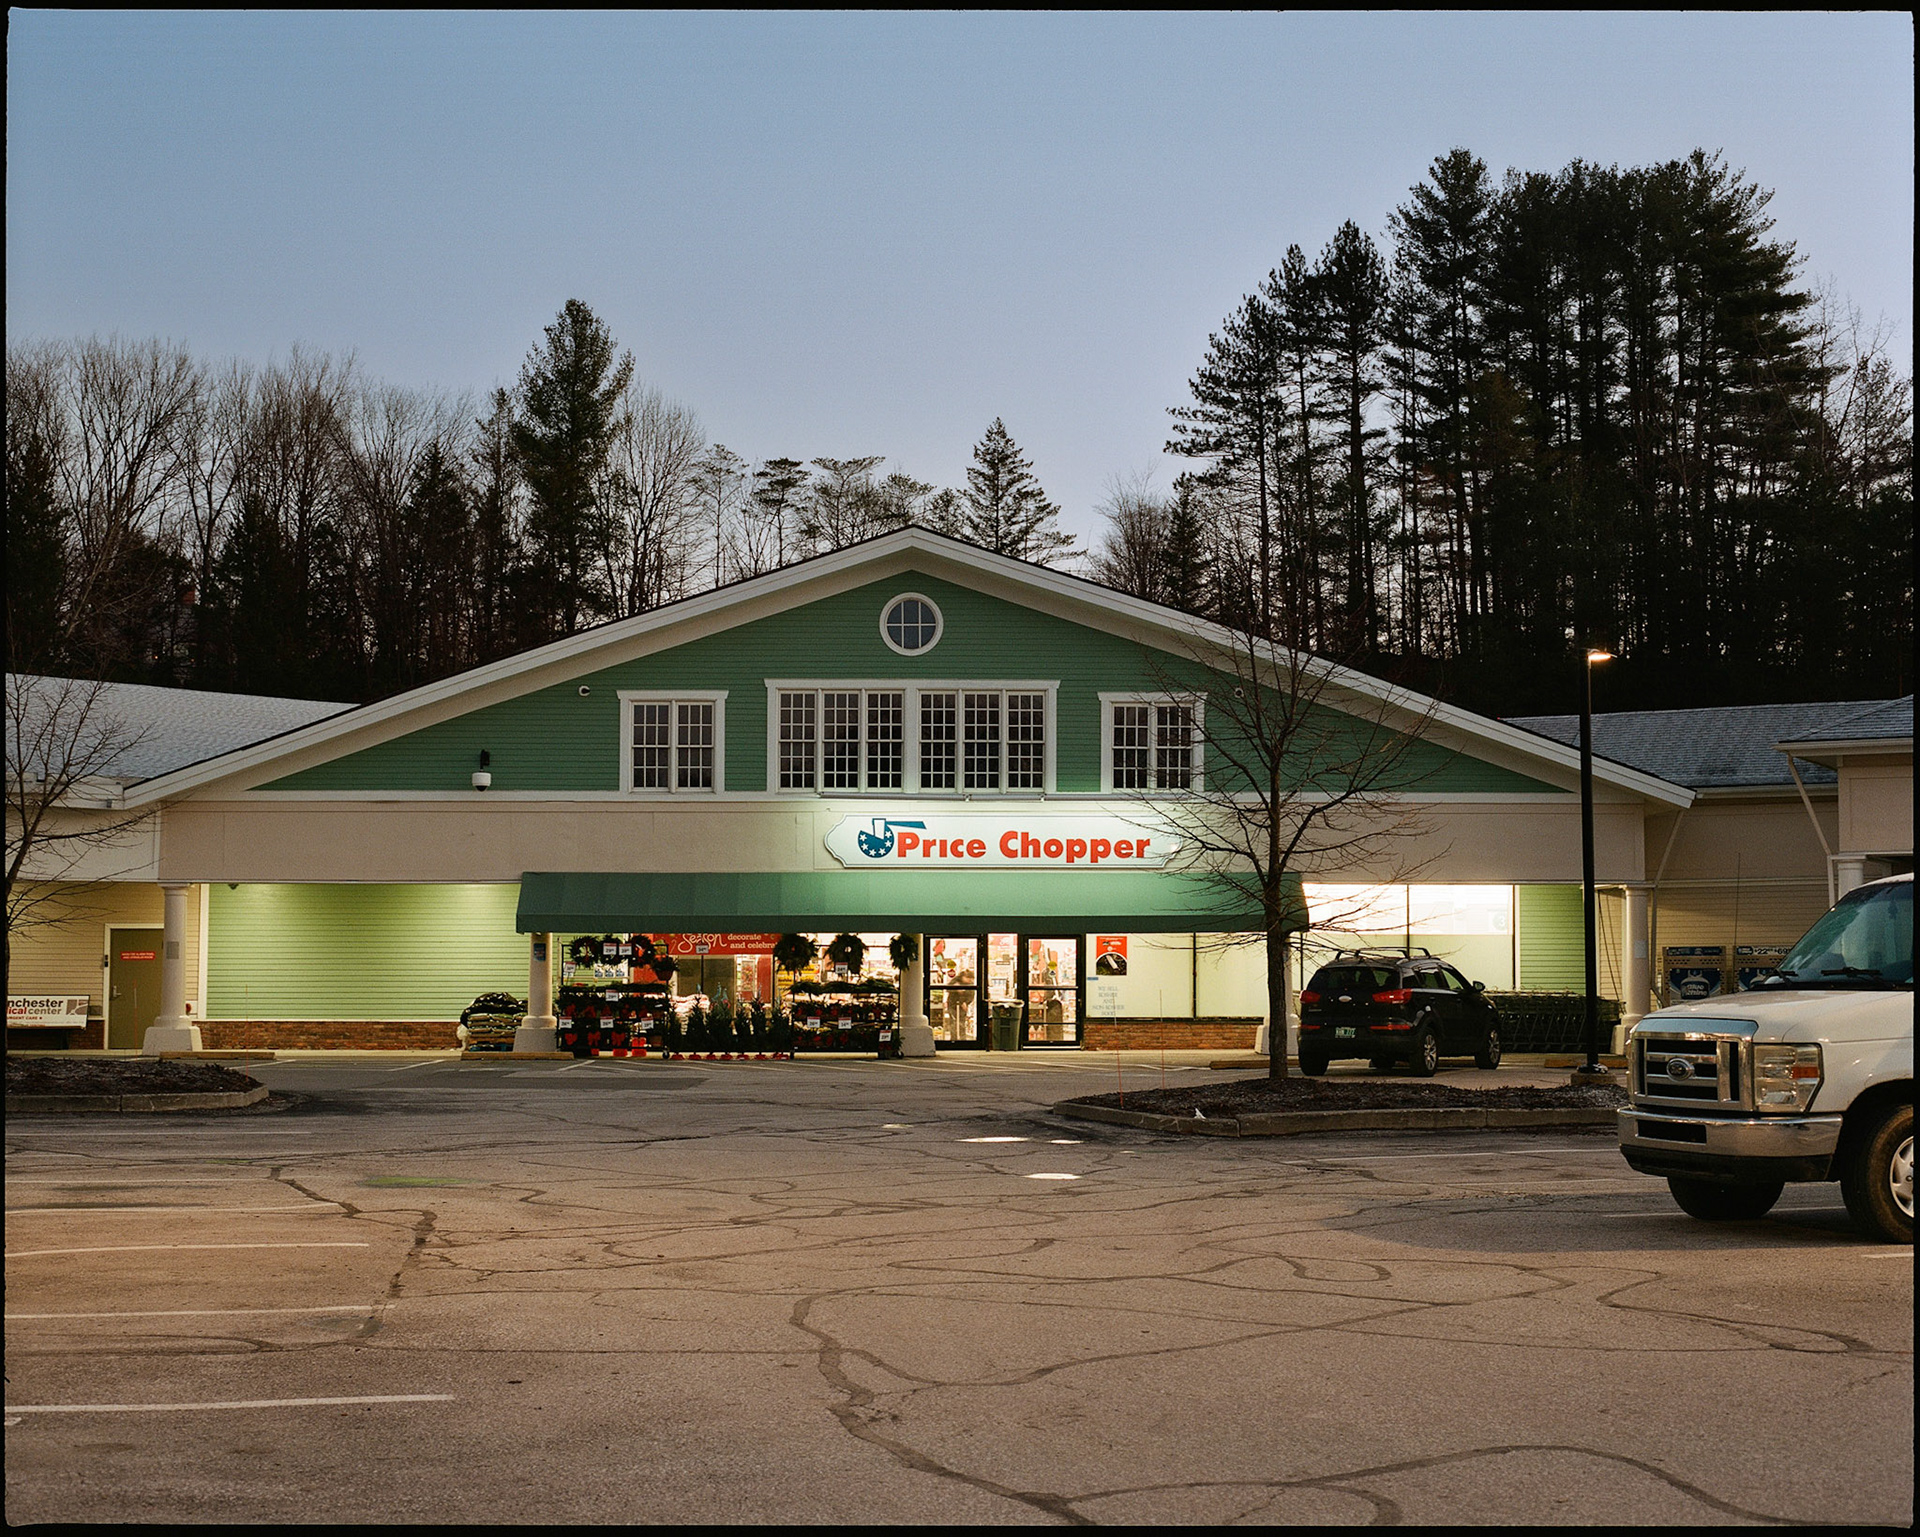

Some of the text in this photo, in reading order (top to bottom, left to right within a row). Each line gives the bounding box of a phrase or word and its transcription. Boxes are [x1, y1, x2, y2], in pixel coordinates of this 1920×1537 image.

[897, 830, 1151, 863] Price Chopper
[7, 1007, 27, 1015] ical
